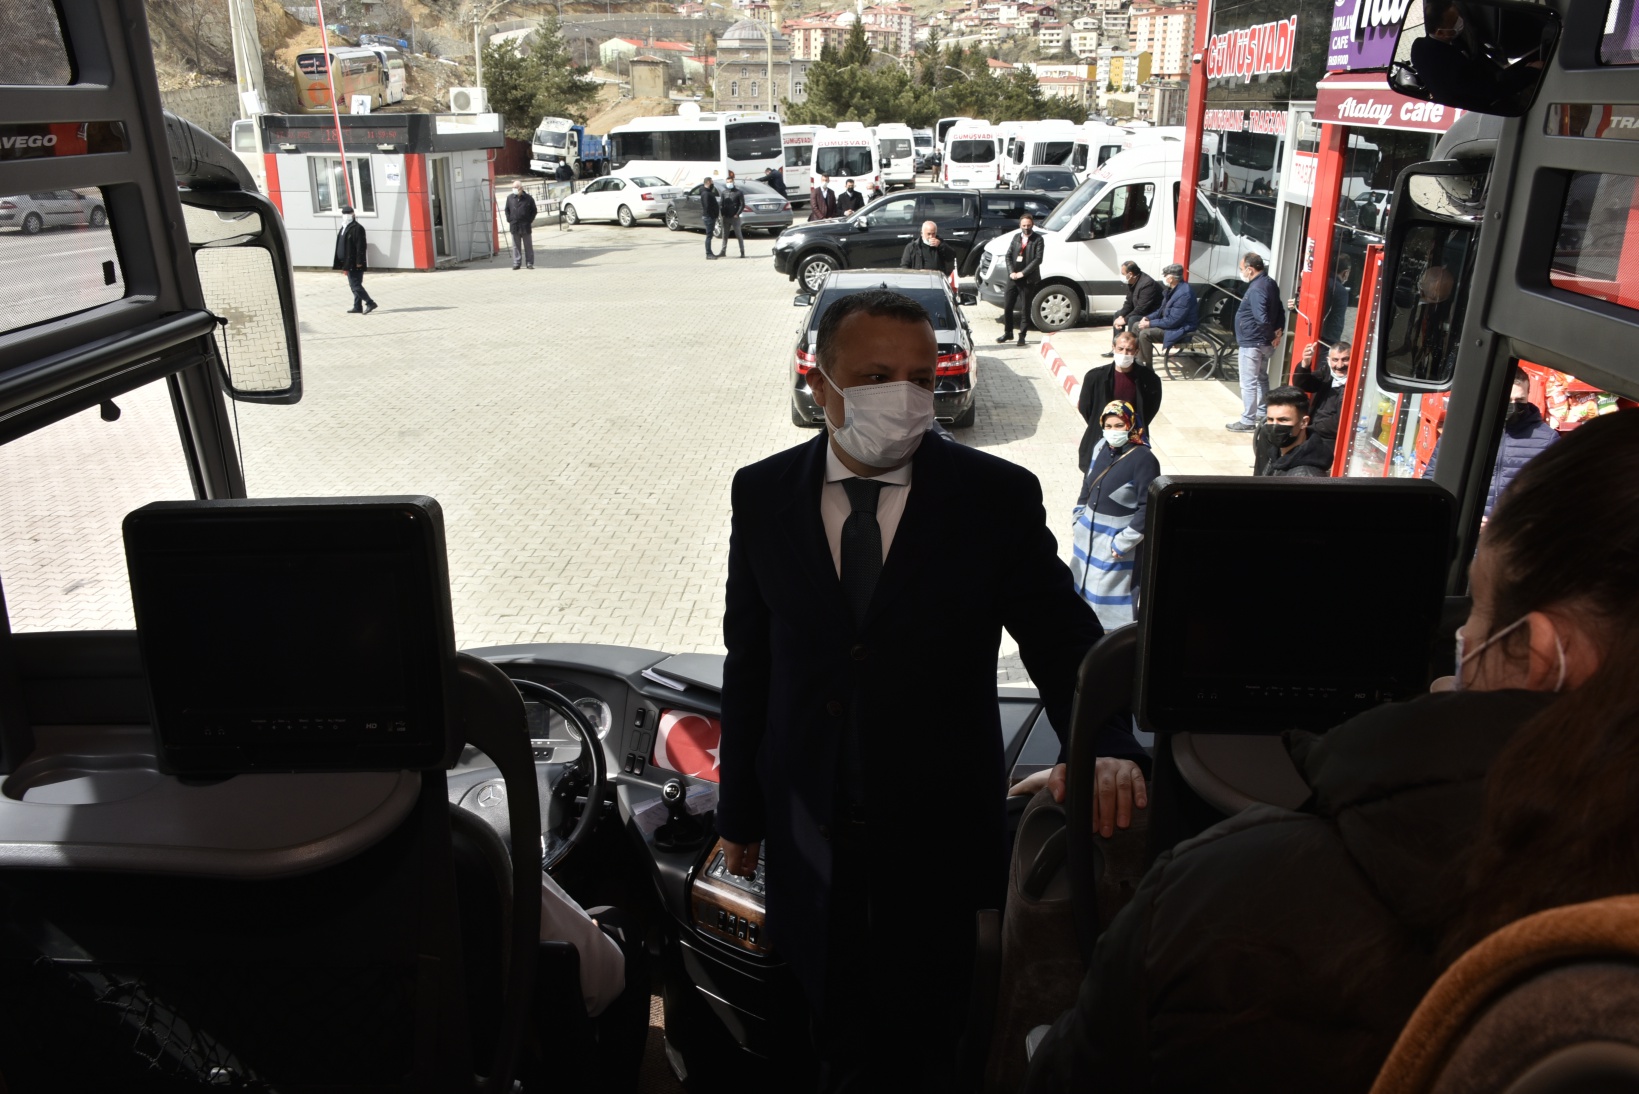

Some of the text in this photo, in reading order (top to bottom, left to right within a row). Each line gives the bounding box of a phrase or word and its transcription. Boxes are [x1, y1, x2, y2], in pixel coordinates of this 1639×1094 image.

[1332, 35, 1349, 50] CAFE
[1338, 97, 1393, 125] Atalay
[0, 134, 58, 149] VEGO
